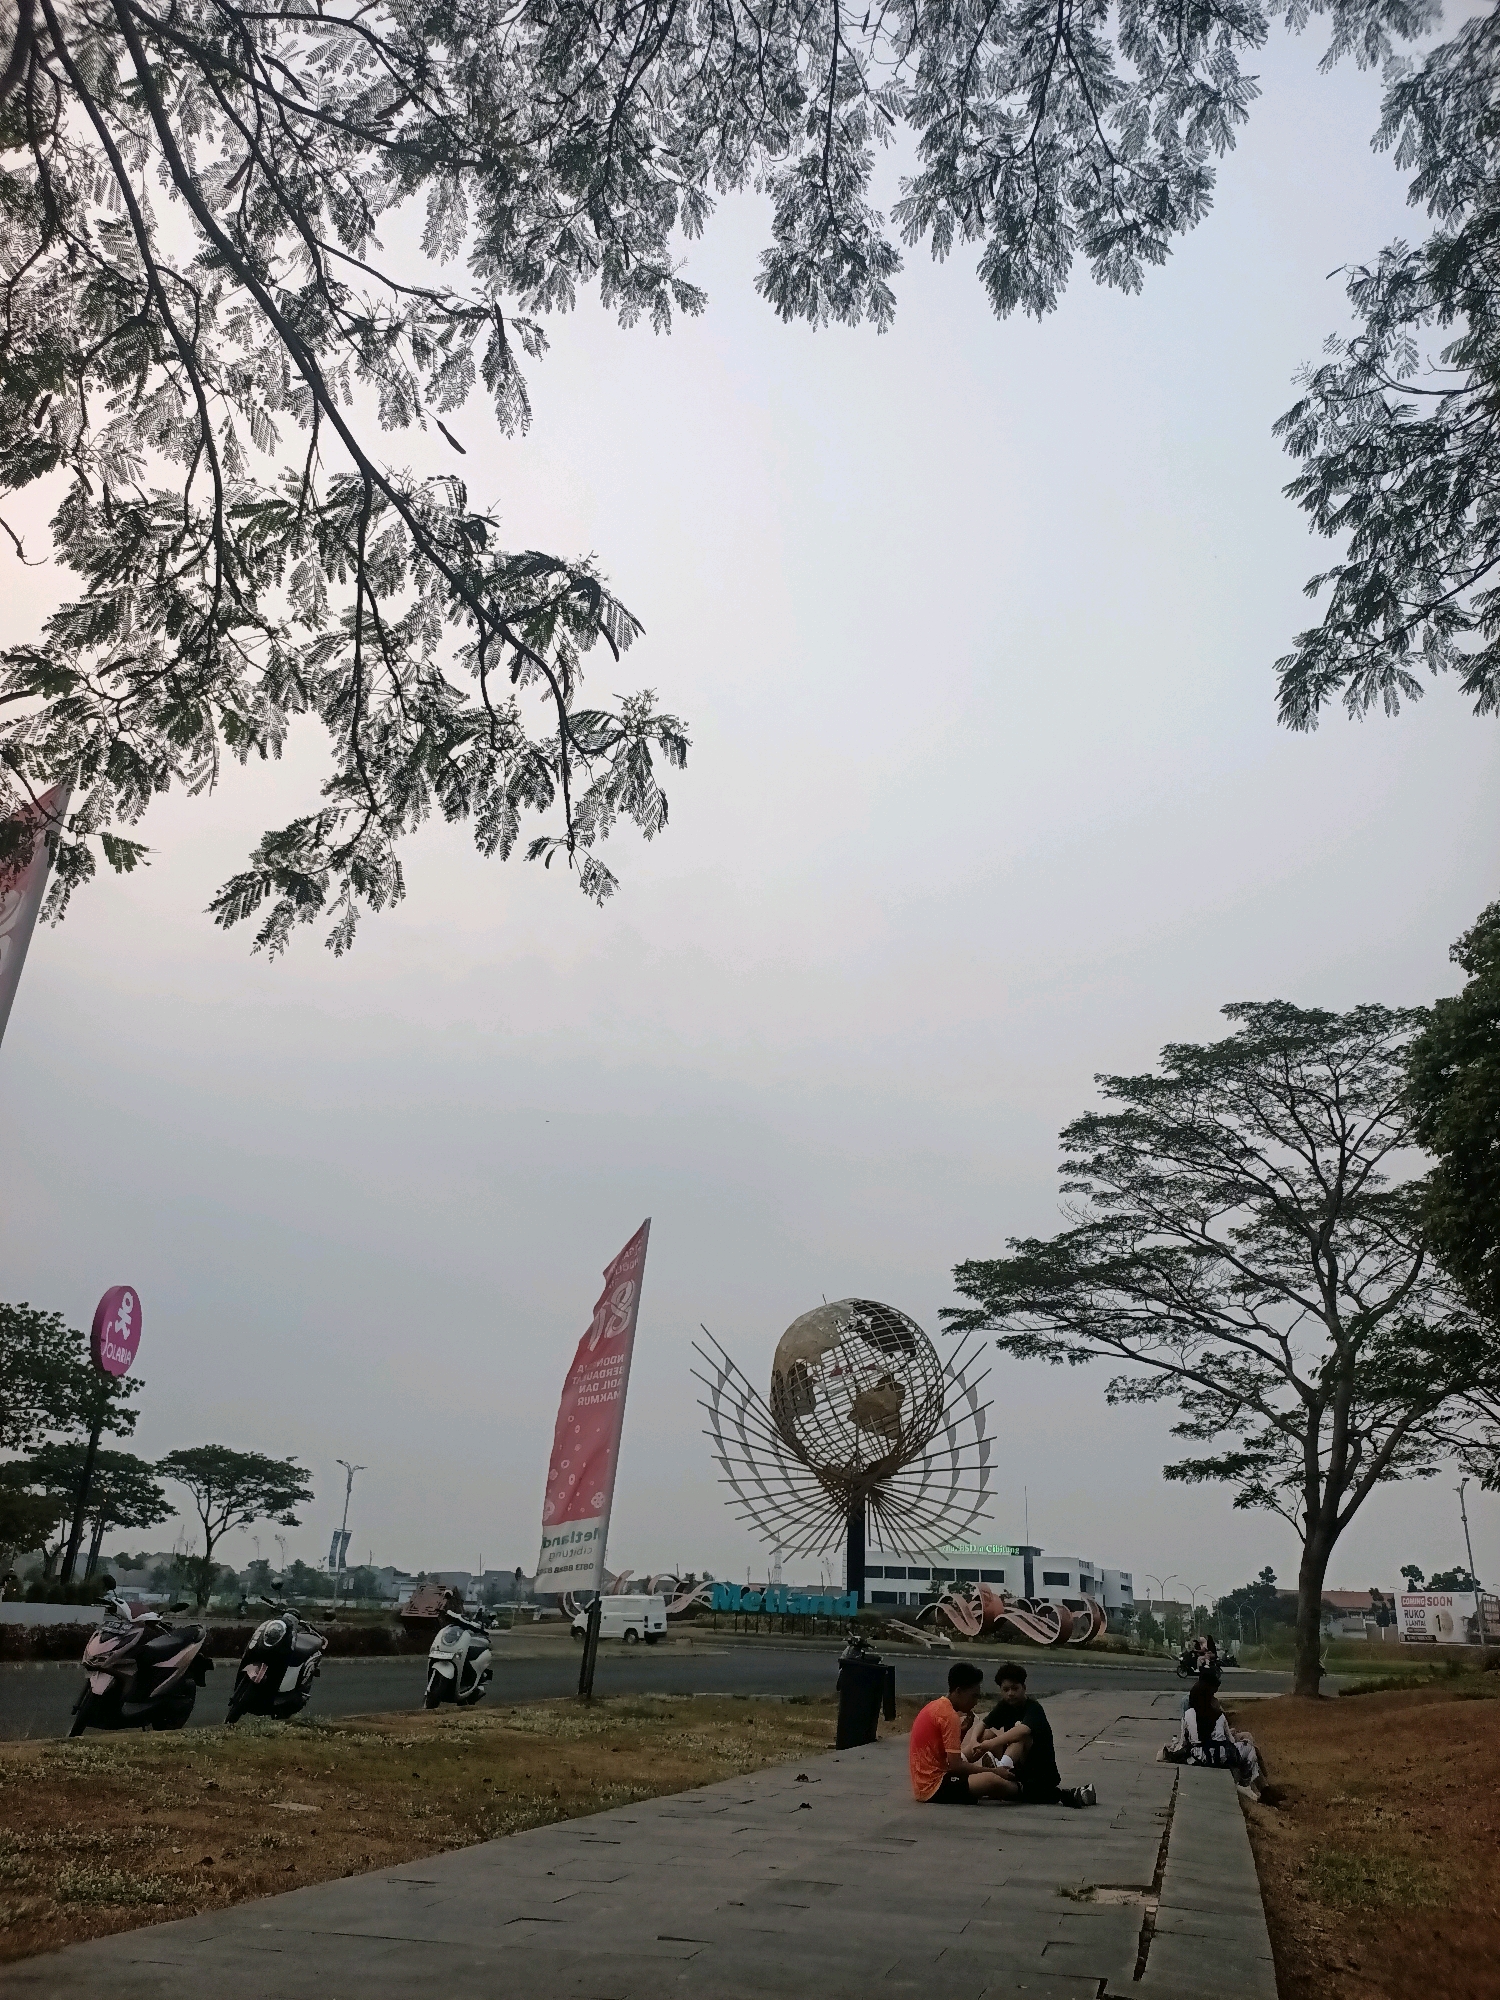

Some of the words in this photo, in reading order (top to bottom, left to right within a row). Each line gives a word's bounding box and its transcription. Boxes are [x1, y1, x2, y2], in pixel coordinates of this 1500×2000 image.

[711, 1582, 858, 1616] Metland
[1402, 1597, 1425, 1606] COMING
[1427, 1596, 1452, 1606] SOON
[1404, 1610, 1425, 1618] RUKO
